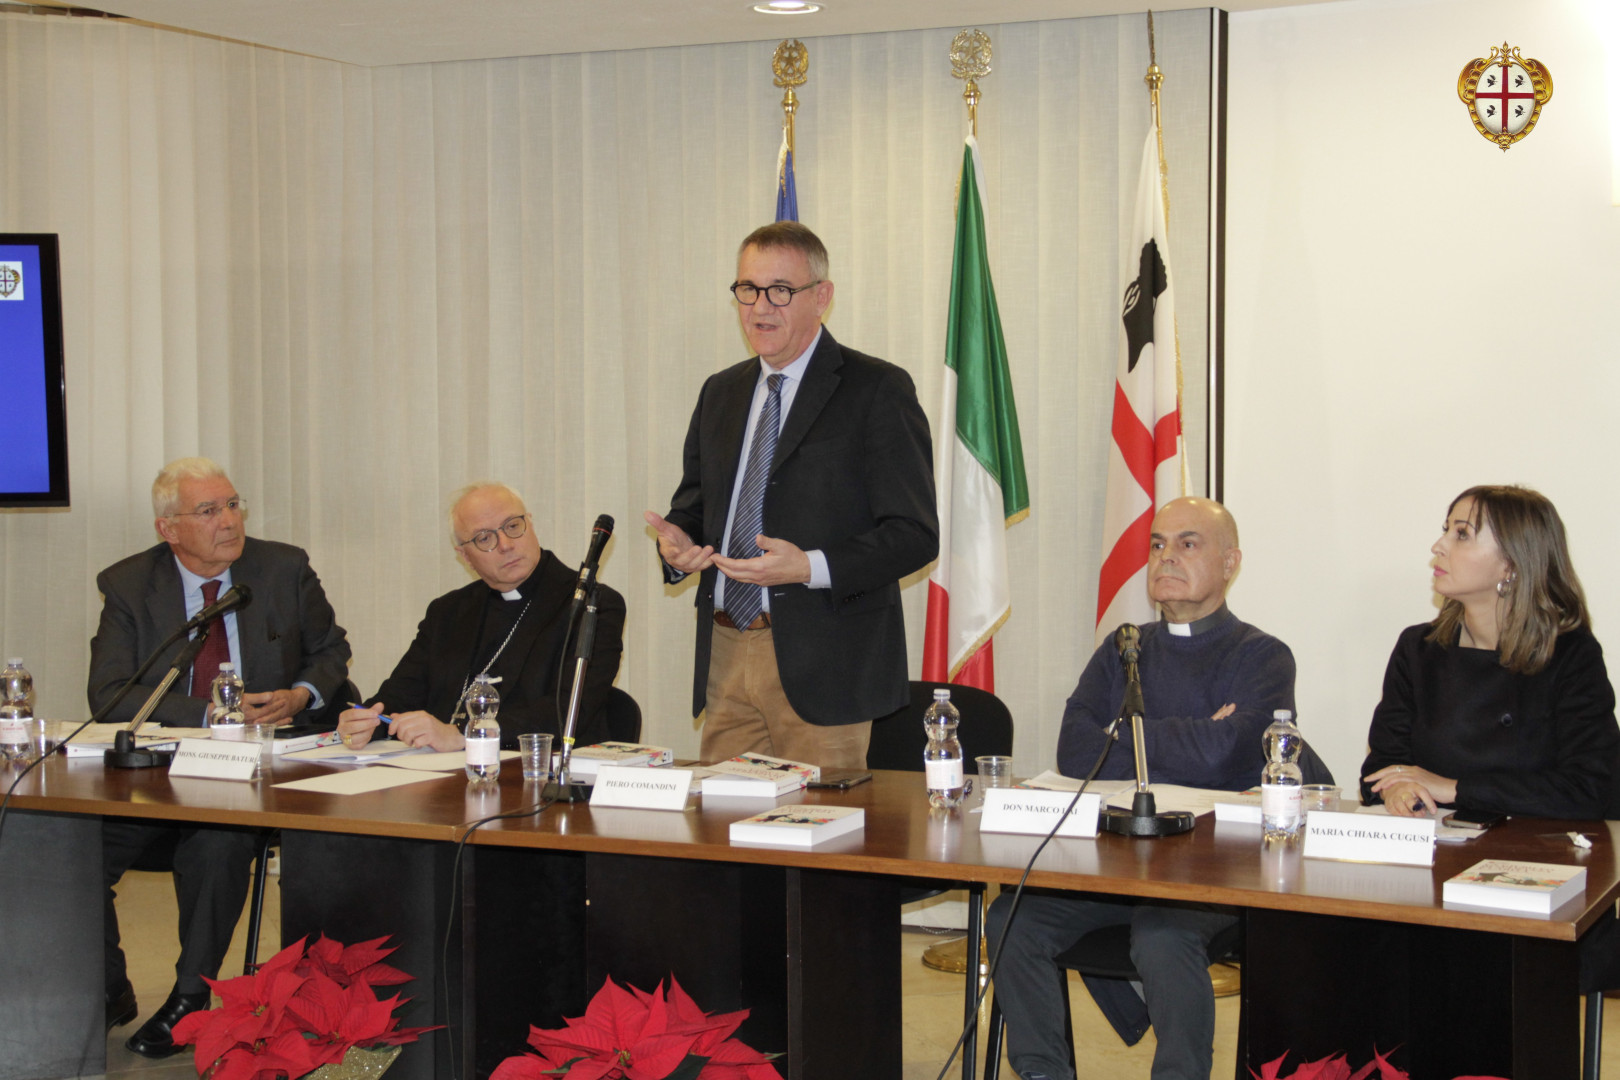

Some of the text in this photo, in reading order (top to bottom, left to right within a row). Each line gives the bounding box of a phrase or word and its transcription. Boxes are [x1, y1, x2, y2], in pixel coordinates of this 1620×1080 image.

[198, 752, 229, 761] GIUSEPPE
[605, 780, 677, 791] PIERO COMANDINI
[1003, 803, 1023, 811] DON
[1025, 804, 1060, 814] MARCO
[1311, 827, 1430, 843] MARIA CHIARA CUGUSI
